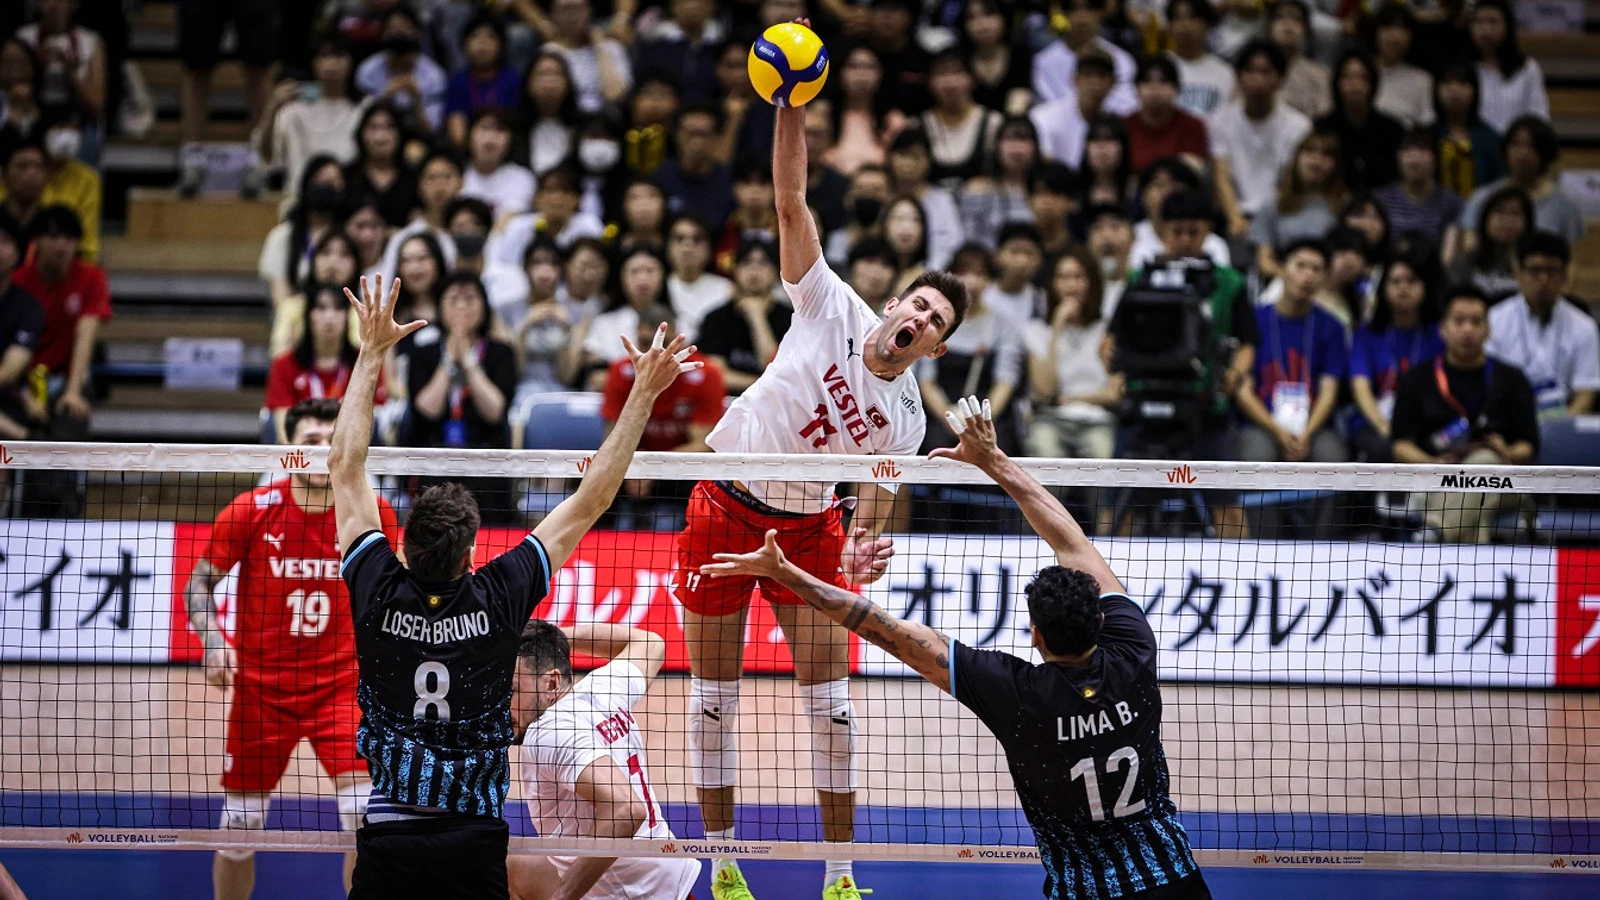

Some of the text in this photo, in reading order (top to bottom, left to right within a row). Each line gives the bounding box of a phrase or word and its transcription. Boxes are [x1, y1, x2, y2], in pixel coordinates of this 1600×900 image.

[823, 363, 869, 447] VESTEL
[280, 450, 310, 469] VNL
[872, 459, 902, 478] VNL
[1167, 464, 1197, 484] VNL
[1440, 469, 1513, 488] MIKASA
[269, 556, 342, 579] VESTE
[0, 551, 152, 631] イオ
[686, 571, 701, 592] 11
[286, 588, 331, 637] 19
[381, 608, 490, 645] LOSER BRUNO
[413, 661, 451, 723] 8
[1057, 700, 1139, 741] LIMA B.
[1070, 746, 1147, 821] 12
[88, 834, 156, 843] VOLLEYBALL
[682, 845, 750, 854] VOLLEYBALL
[978, 850, 1040, 859] VOLLEYBAL
[1274, 856, 1341, 864] VOLLEYBALL
[1571, 860, 1600, 869] VOLL
